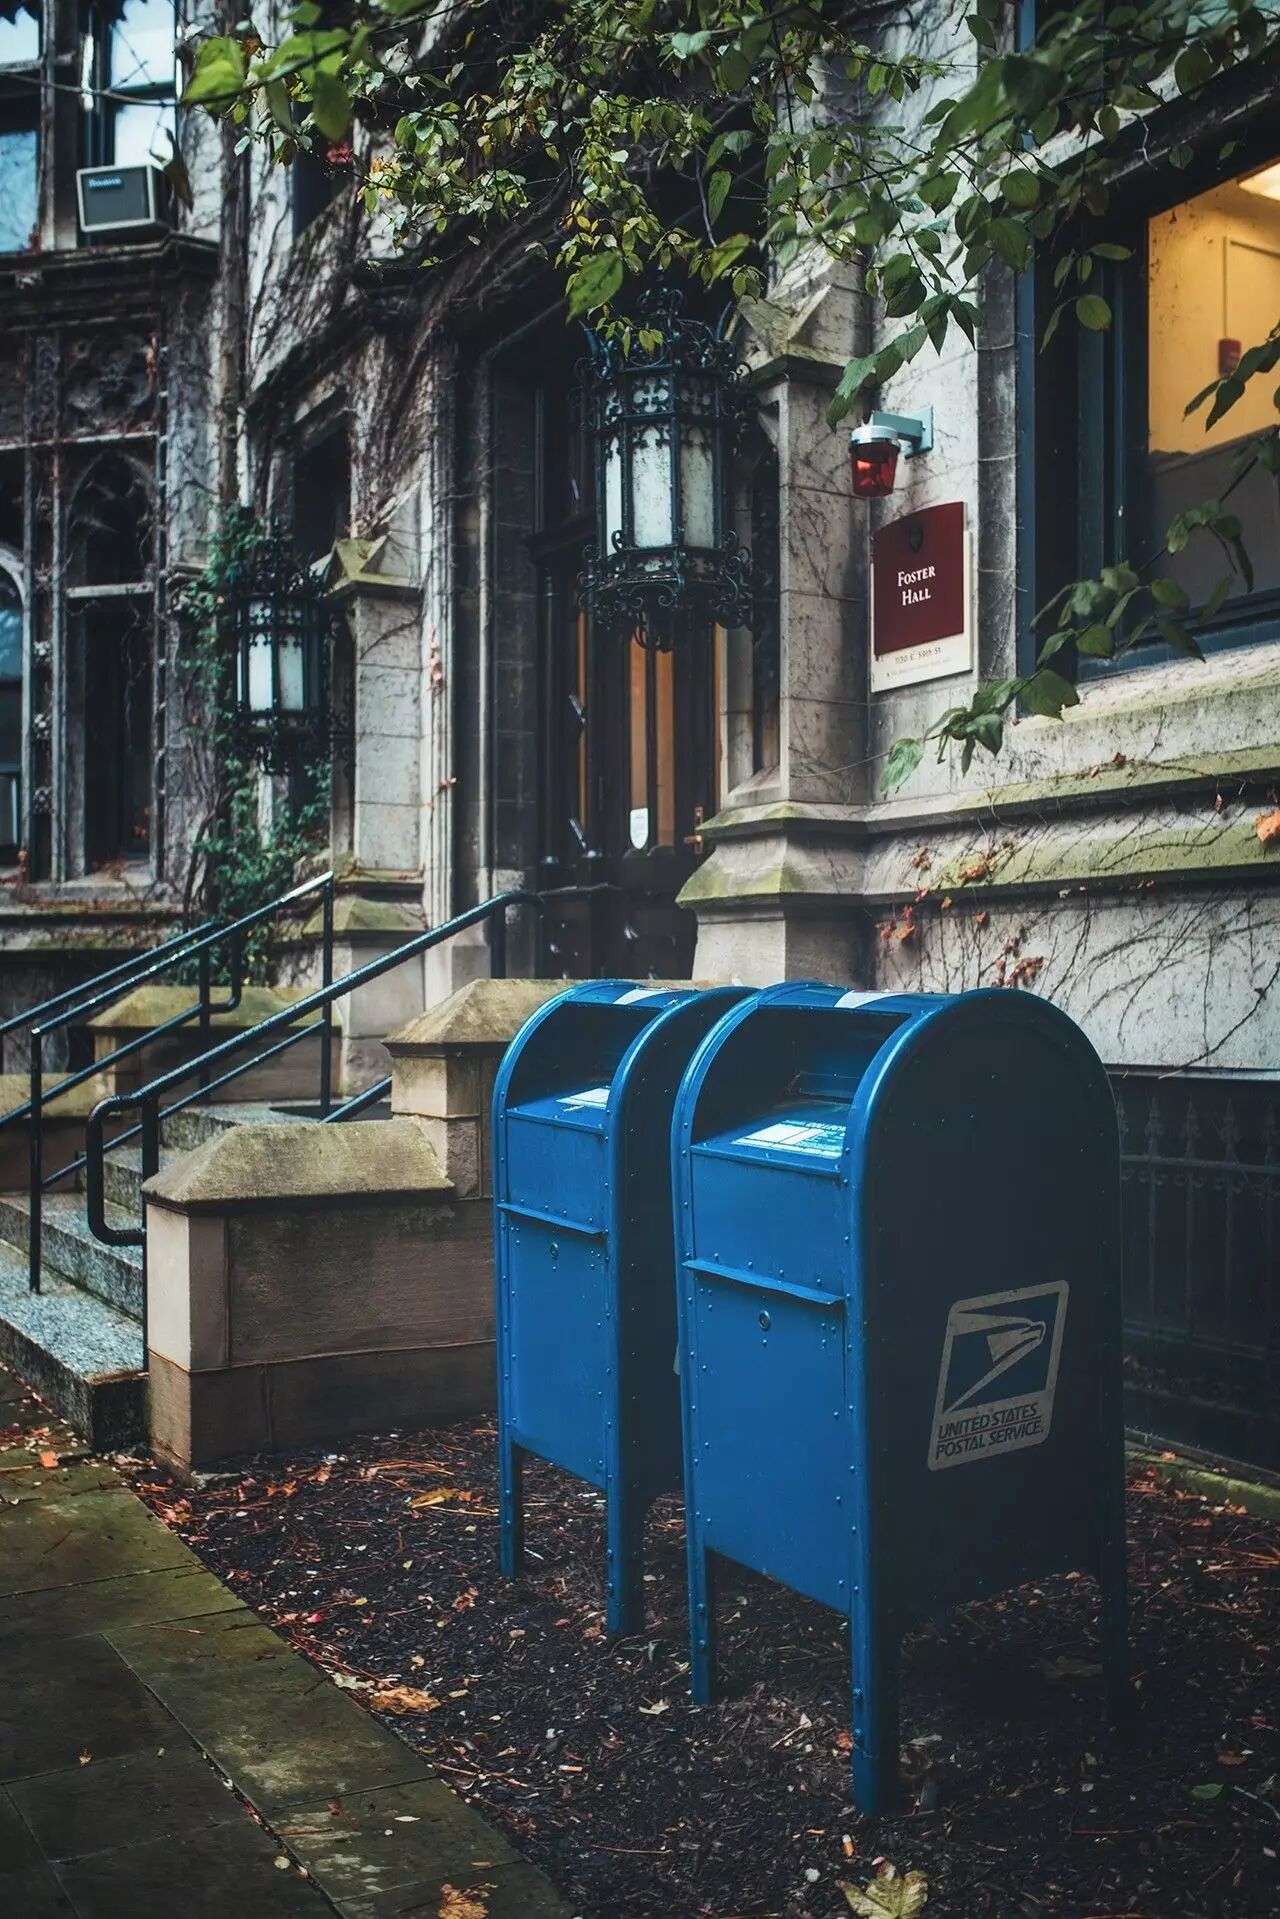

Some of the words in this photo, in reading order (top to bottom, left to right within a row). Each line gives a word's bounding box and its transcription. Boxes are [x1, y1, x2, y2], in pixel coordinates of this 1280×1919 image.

[898, 565, 936, 587] FOSTER
[902, 588, 931, 606] HALL
[938, 1413, 990, 1439] UNITED
[991, 1401, 1038, 1426] STATES
[935, 1433, 986, 1460] POSTAL
